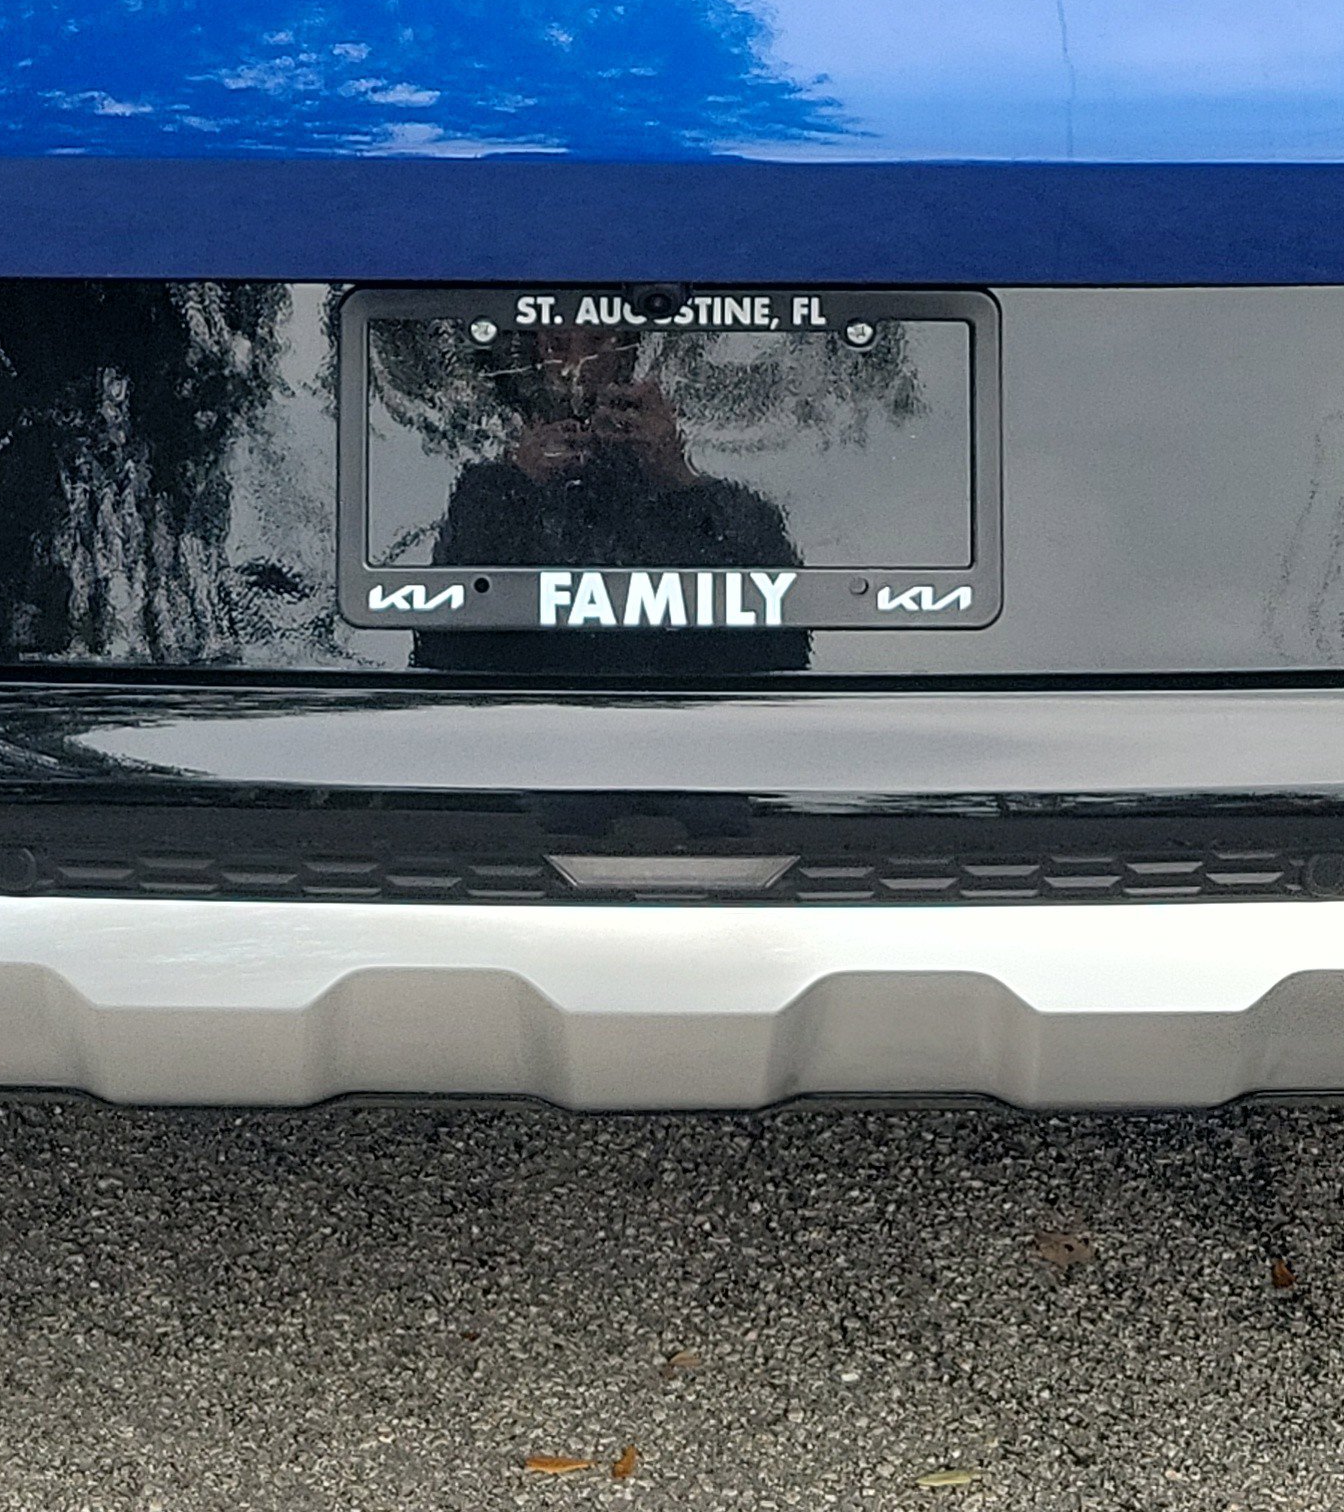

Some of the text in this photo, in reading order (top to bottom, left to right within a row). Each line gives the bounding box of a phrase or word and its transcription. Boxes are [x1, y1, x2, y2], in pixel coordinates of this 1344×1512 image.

[515, 296, 827, 330] ST. AUSTINE, FL
[368, 584, 464, 612] KIA
[539, 572, 797, 627] FAMILY
[876, 585, 973, 613] KIA
